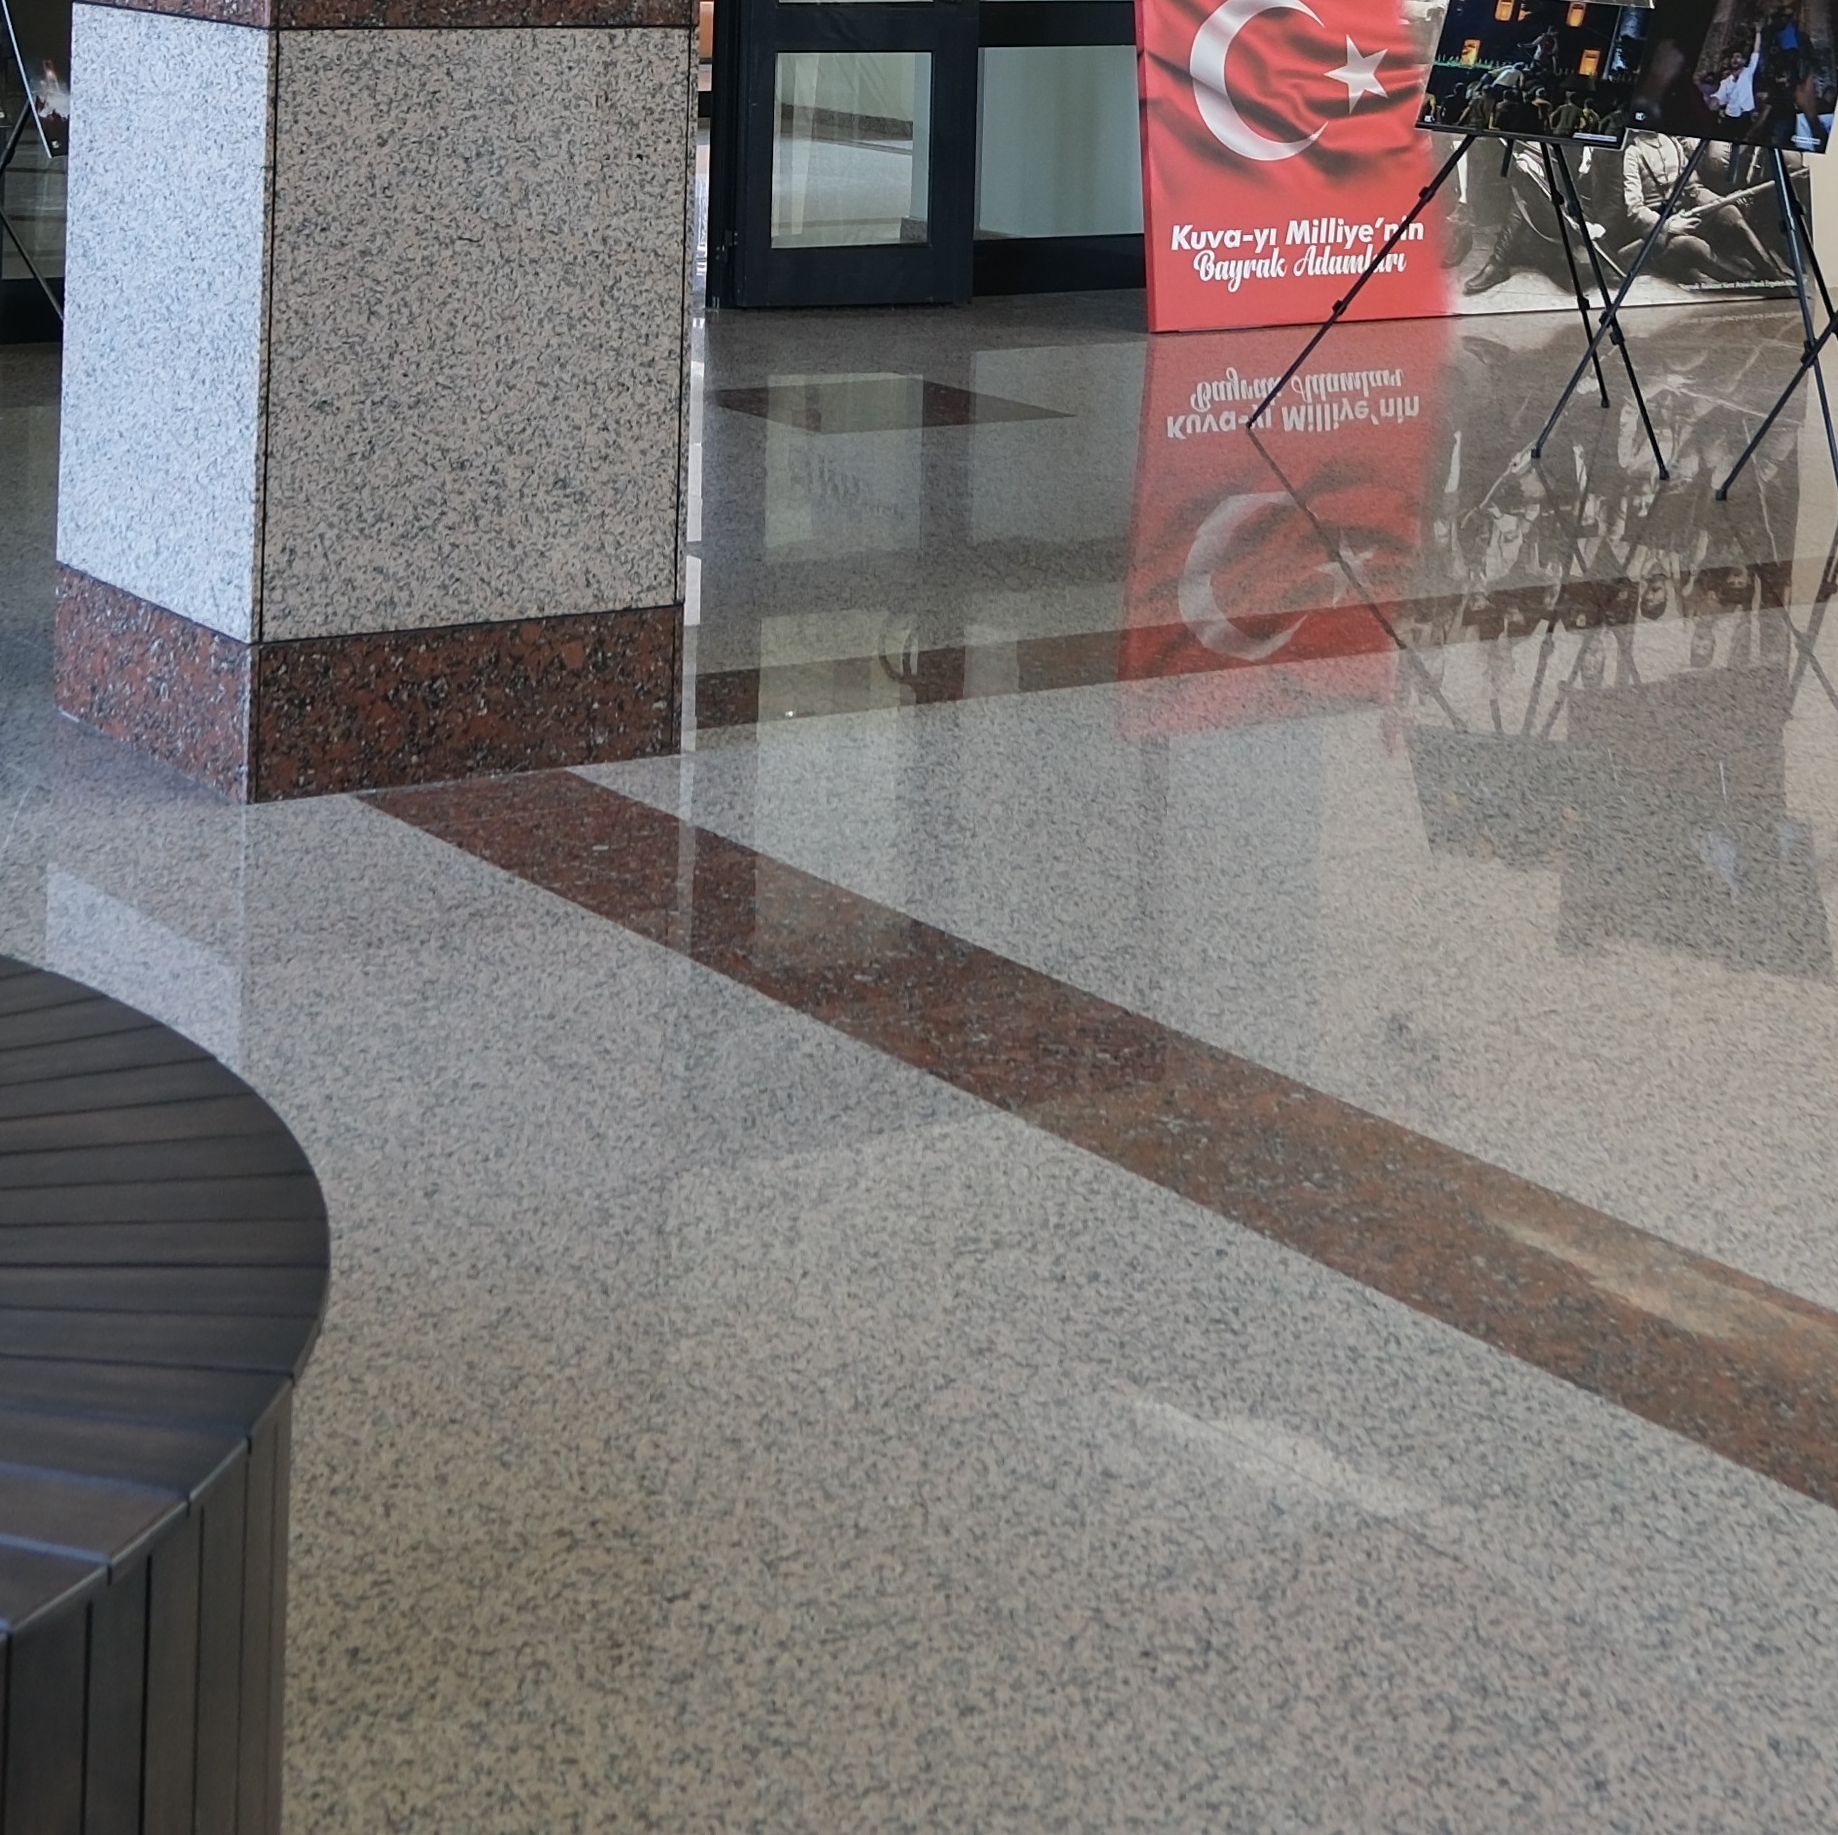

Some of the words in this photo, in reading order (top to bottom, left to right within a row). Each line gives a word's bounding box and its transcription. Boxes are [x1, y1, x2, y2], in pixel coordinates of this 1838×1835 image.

[1171, 224, 1277, 253] Kuva-yı
[1285, 215, 1424, 250] Milliye'nin
[1193, 249, 1288, 293] Bayrak
